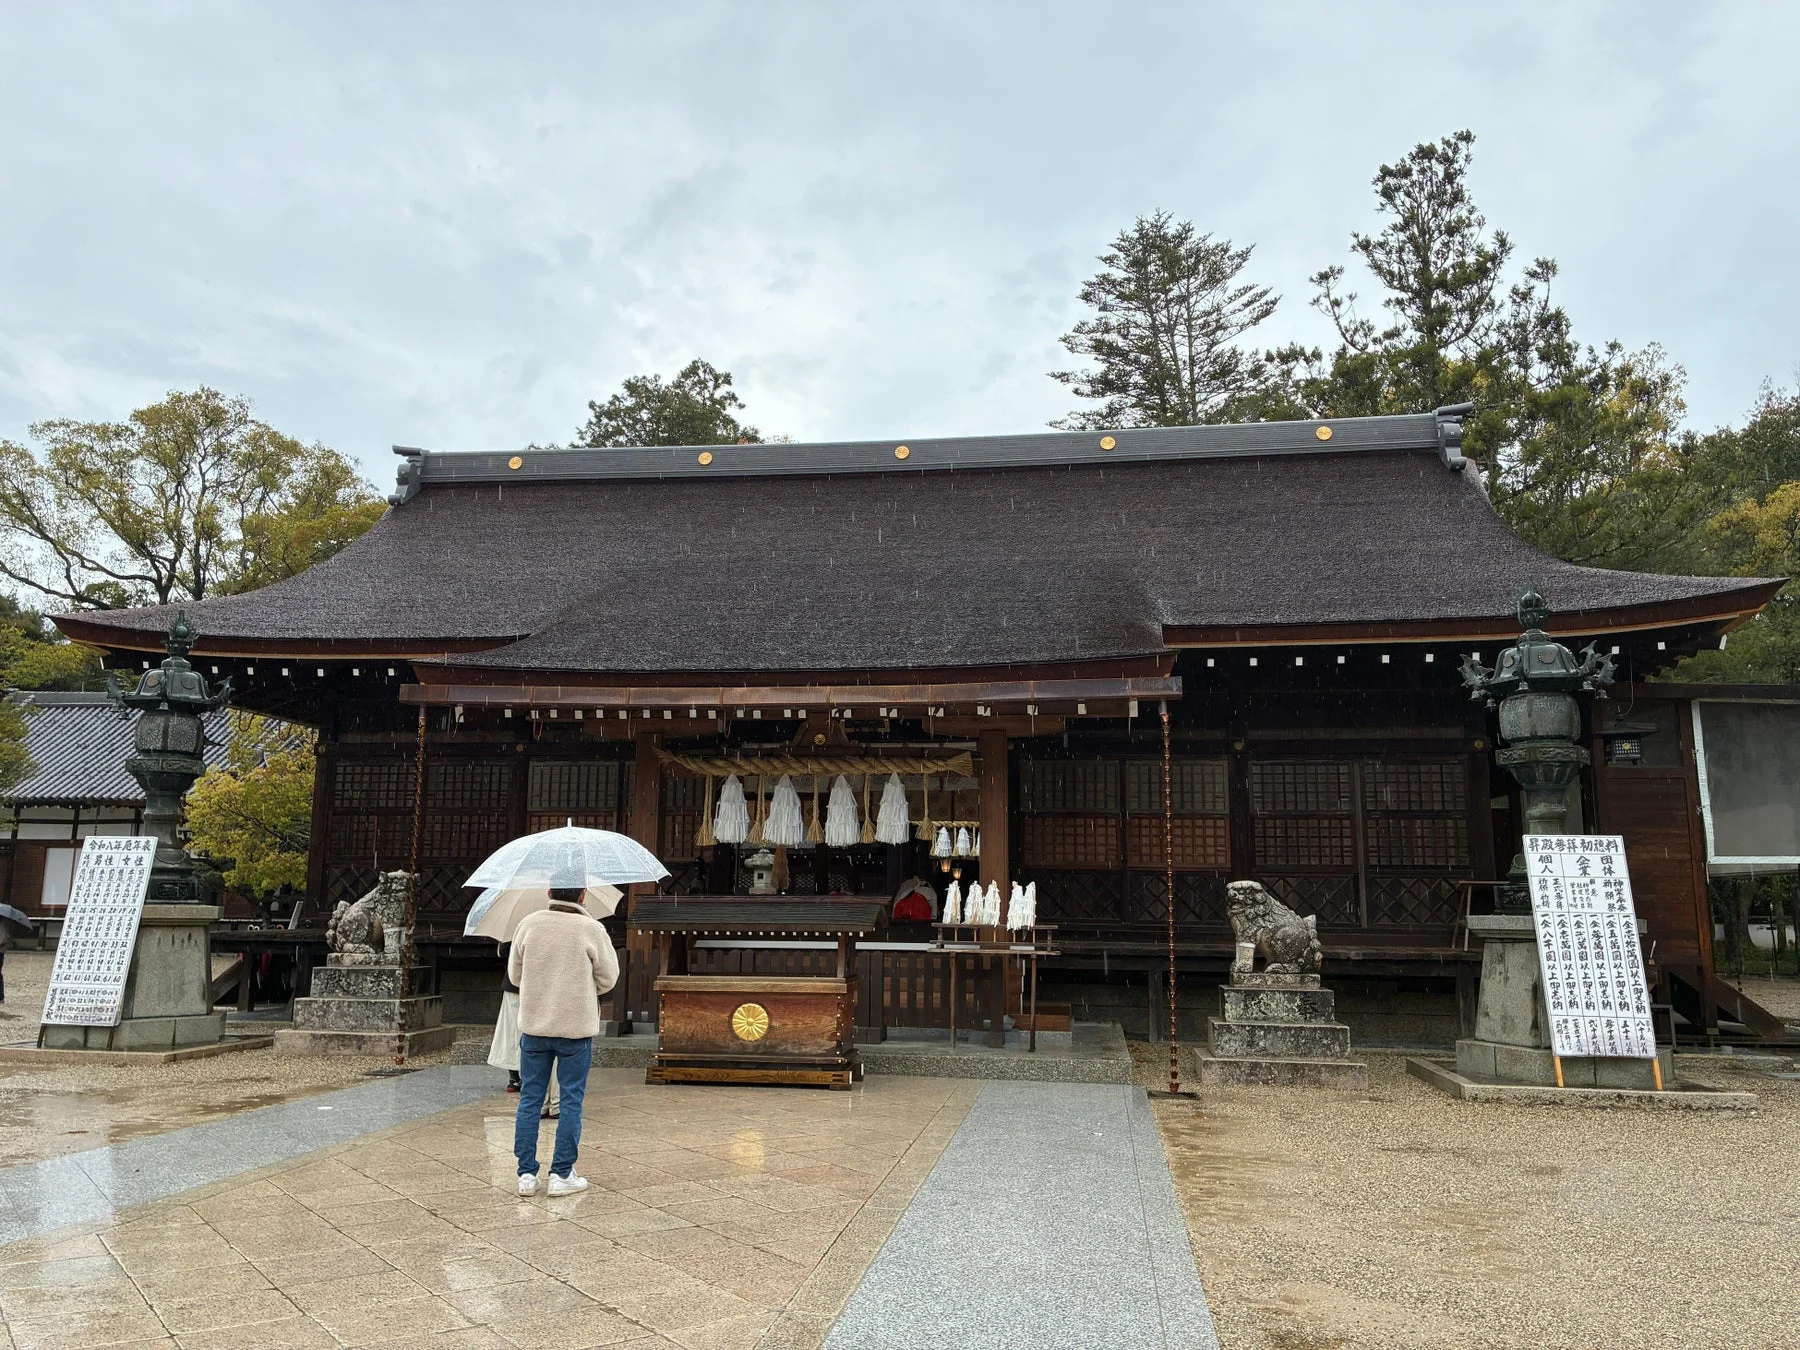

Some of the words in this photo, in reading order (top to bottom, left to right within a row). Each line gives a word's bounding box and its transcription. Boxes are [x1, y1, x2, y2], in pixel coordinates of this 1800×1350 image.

[94, 854, 114, 866] 男性
[122, 855, 144, 866] 女性
[1538, 855, 1554, 874] 個人
[1576, 855, 1591, 876] 企業
[1600, 855, 1616, 876] 団体
